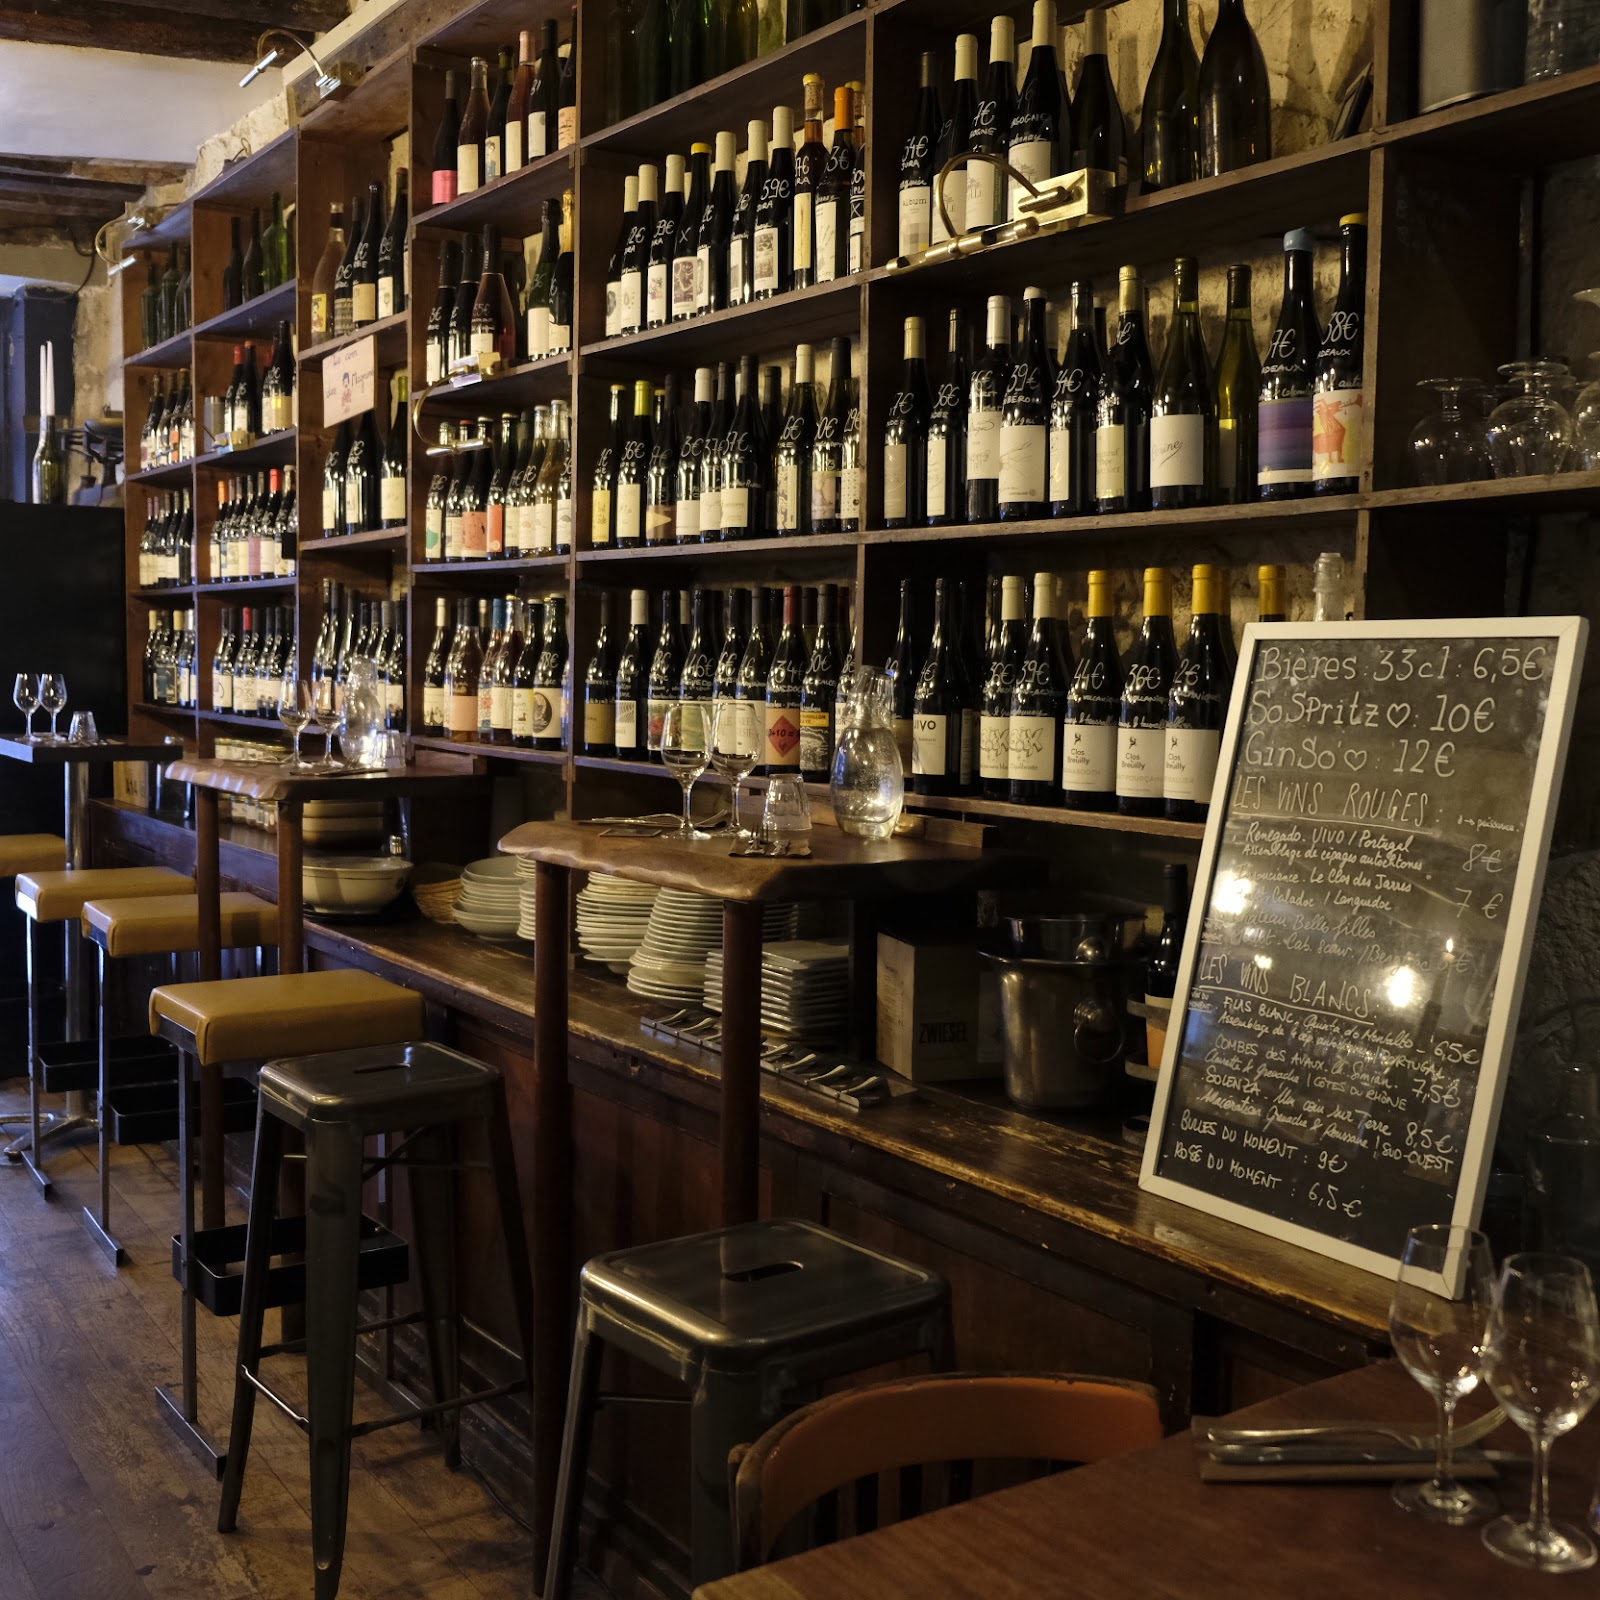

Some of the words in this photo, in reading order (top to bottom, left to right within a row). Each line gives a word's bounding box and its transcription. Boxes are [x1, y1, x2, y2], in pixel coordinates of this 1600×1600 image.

[761, 178, 791, 200] 59€
[1007, 363, 1040, 393] 39€
[1016, 660, 1049, 685] 39€
[1074, 658, 1104, 690] 44€
[1126, 664, 1160, 690] 36€
[1473, 646, 1547, 683] 6,5€
[1430, 695, 1495, 733] 10€
[1071, 748, 1085, 756] Clos
[1126, 752, 1140, 760] Clos
[1169, 753, 1181, 761] Clos
[1393, 739, 1456, 778] 12€
[1233, 775, 1266, 810] LES
[1242, 844, 1301, 865] Assemblage
[1305, 848, 1318, 858] de
[1358, 829, 1414, 856] Portugal
[1462, 844, 1503, 873] 8€
[1310, 867, 1324, 884] Le
[1328, 869, 1350, 885] Clos
[1352, 871, 1372, 887] des
[1375, 874, 1412, 893] Jarres
[1333, 889, 1392, 914] Languedoc
[1292, 914, 1330, 933] Belles
[1200, 953, 1228, 984] LES
[919, 1020, 968, 1044] ZWIESEL
[1218, 1011, 1269, 1038] Assemblage
[1303, 1014, 1340, 1034] Quinta
[1434, 1040, 1480, 1065] 6,5€
[1215, 1033, 1259, 1056] COMBES
[1412, 1078, 1461, 1108] 7,5€
[1206, 1065, 1261, 1096] SOLENZA
[1355, 1109, 1393, 1136] Terre
[1222, 1126, 1237, 1142] DU
[1318, 1151, 1347, 1173] 9€
[1207, 1152, 1224, 1170] DU
[1308, 1182, 1362, 1218] 6,5€
